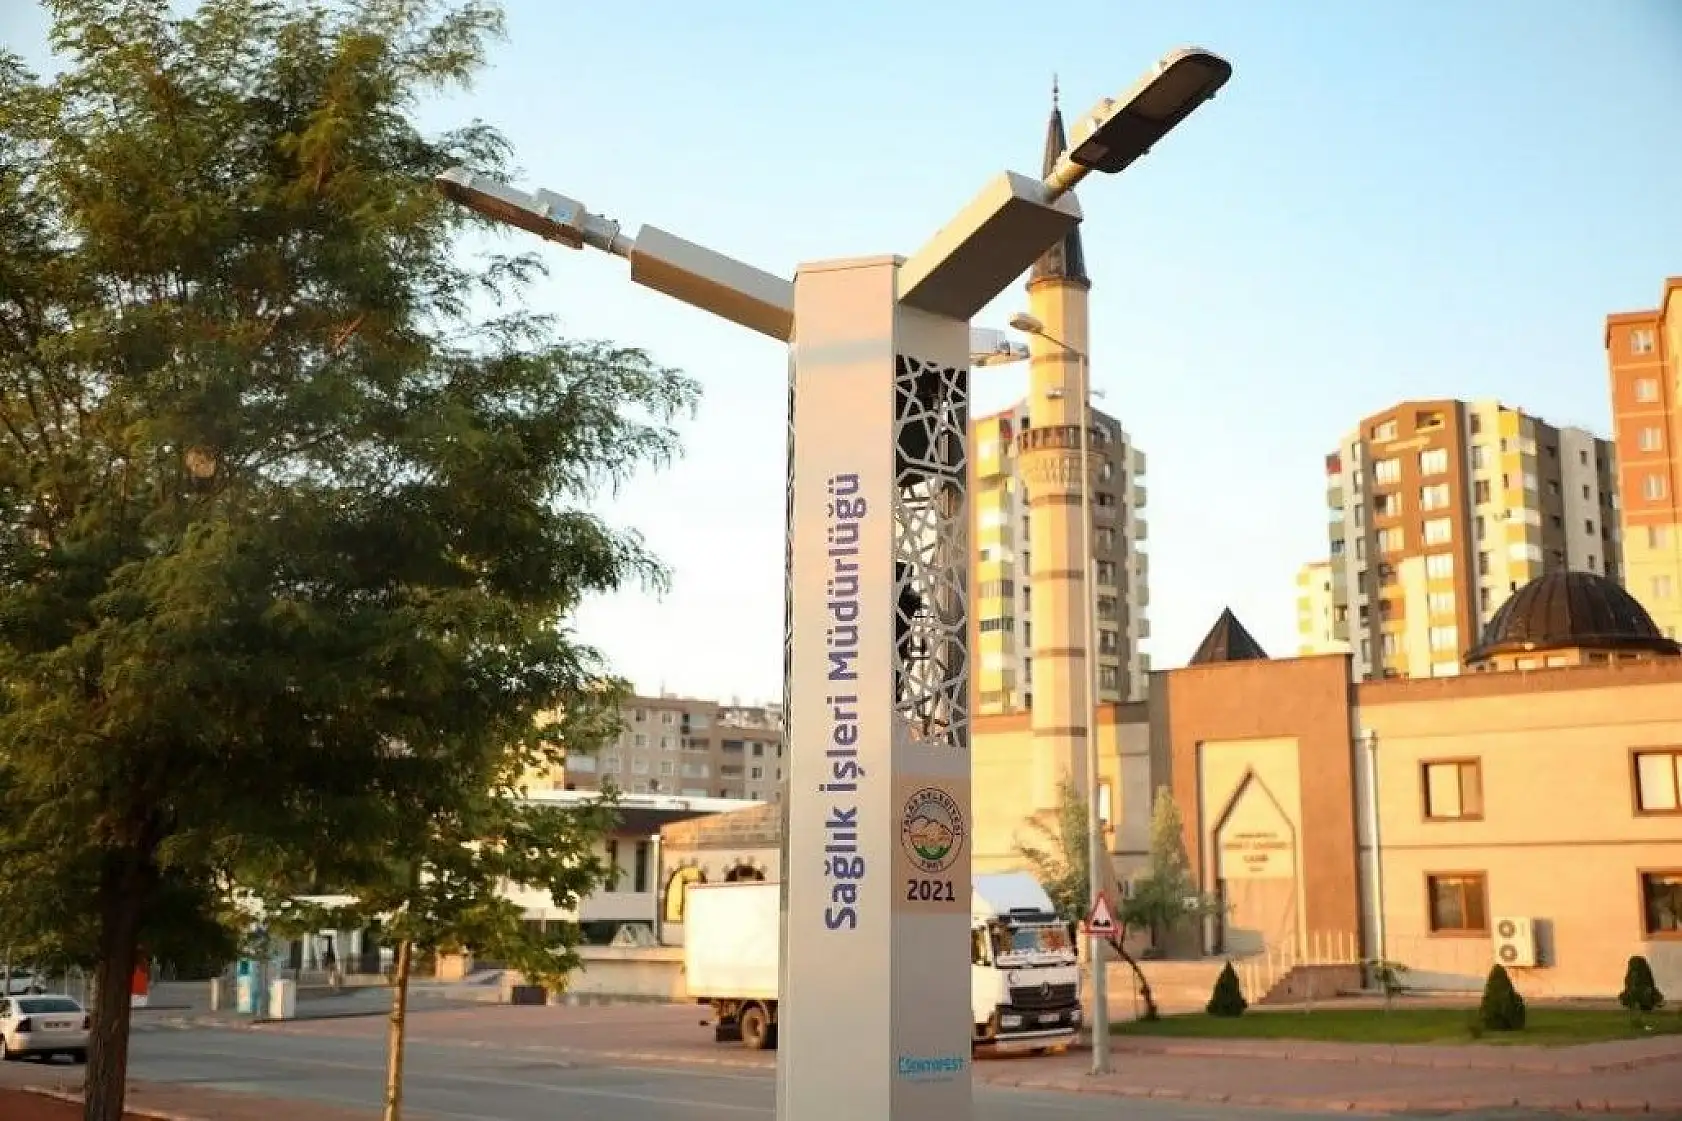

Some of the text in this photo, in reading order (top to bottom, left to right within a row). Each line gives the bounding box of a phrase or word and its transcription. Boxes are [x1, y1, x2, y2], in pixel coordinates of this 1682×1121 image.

[819, 473, 867, 930] Sağlık İşleri Müdürlüğü
[907, 880, 955, 902] 2021
